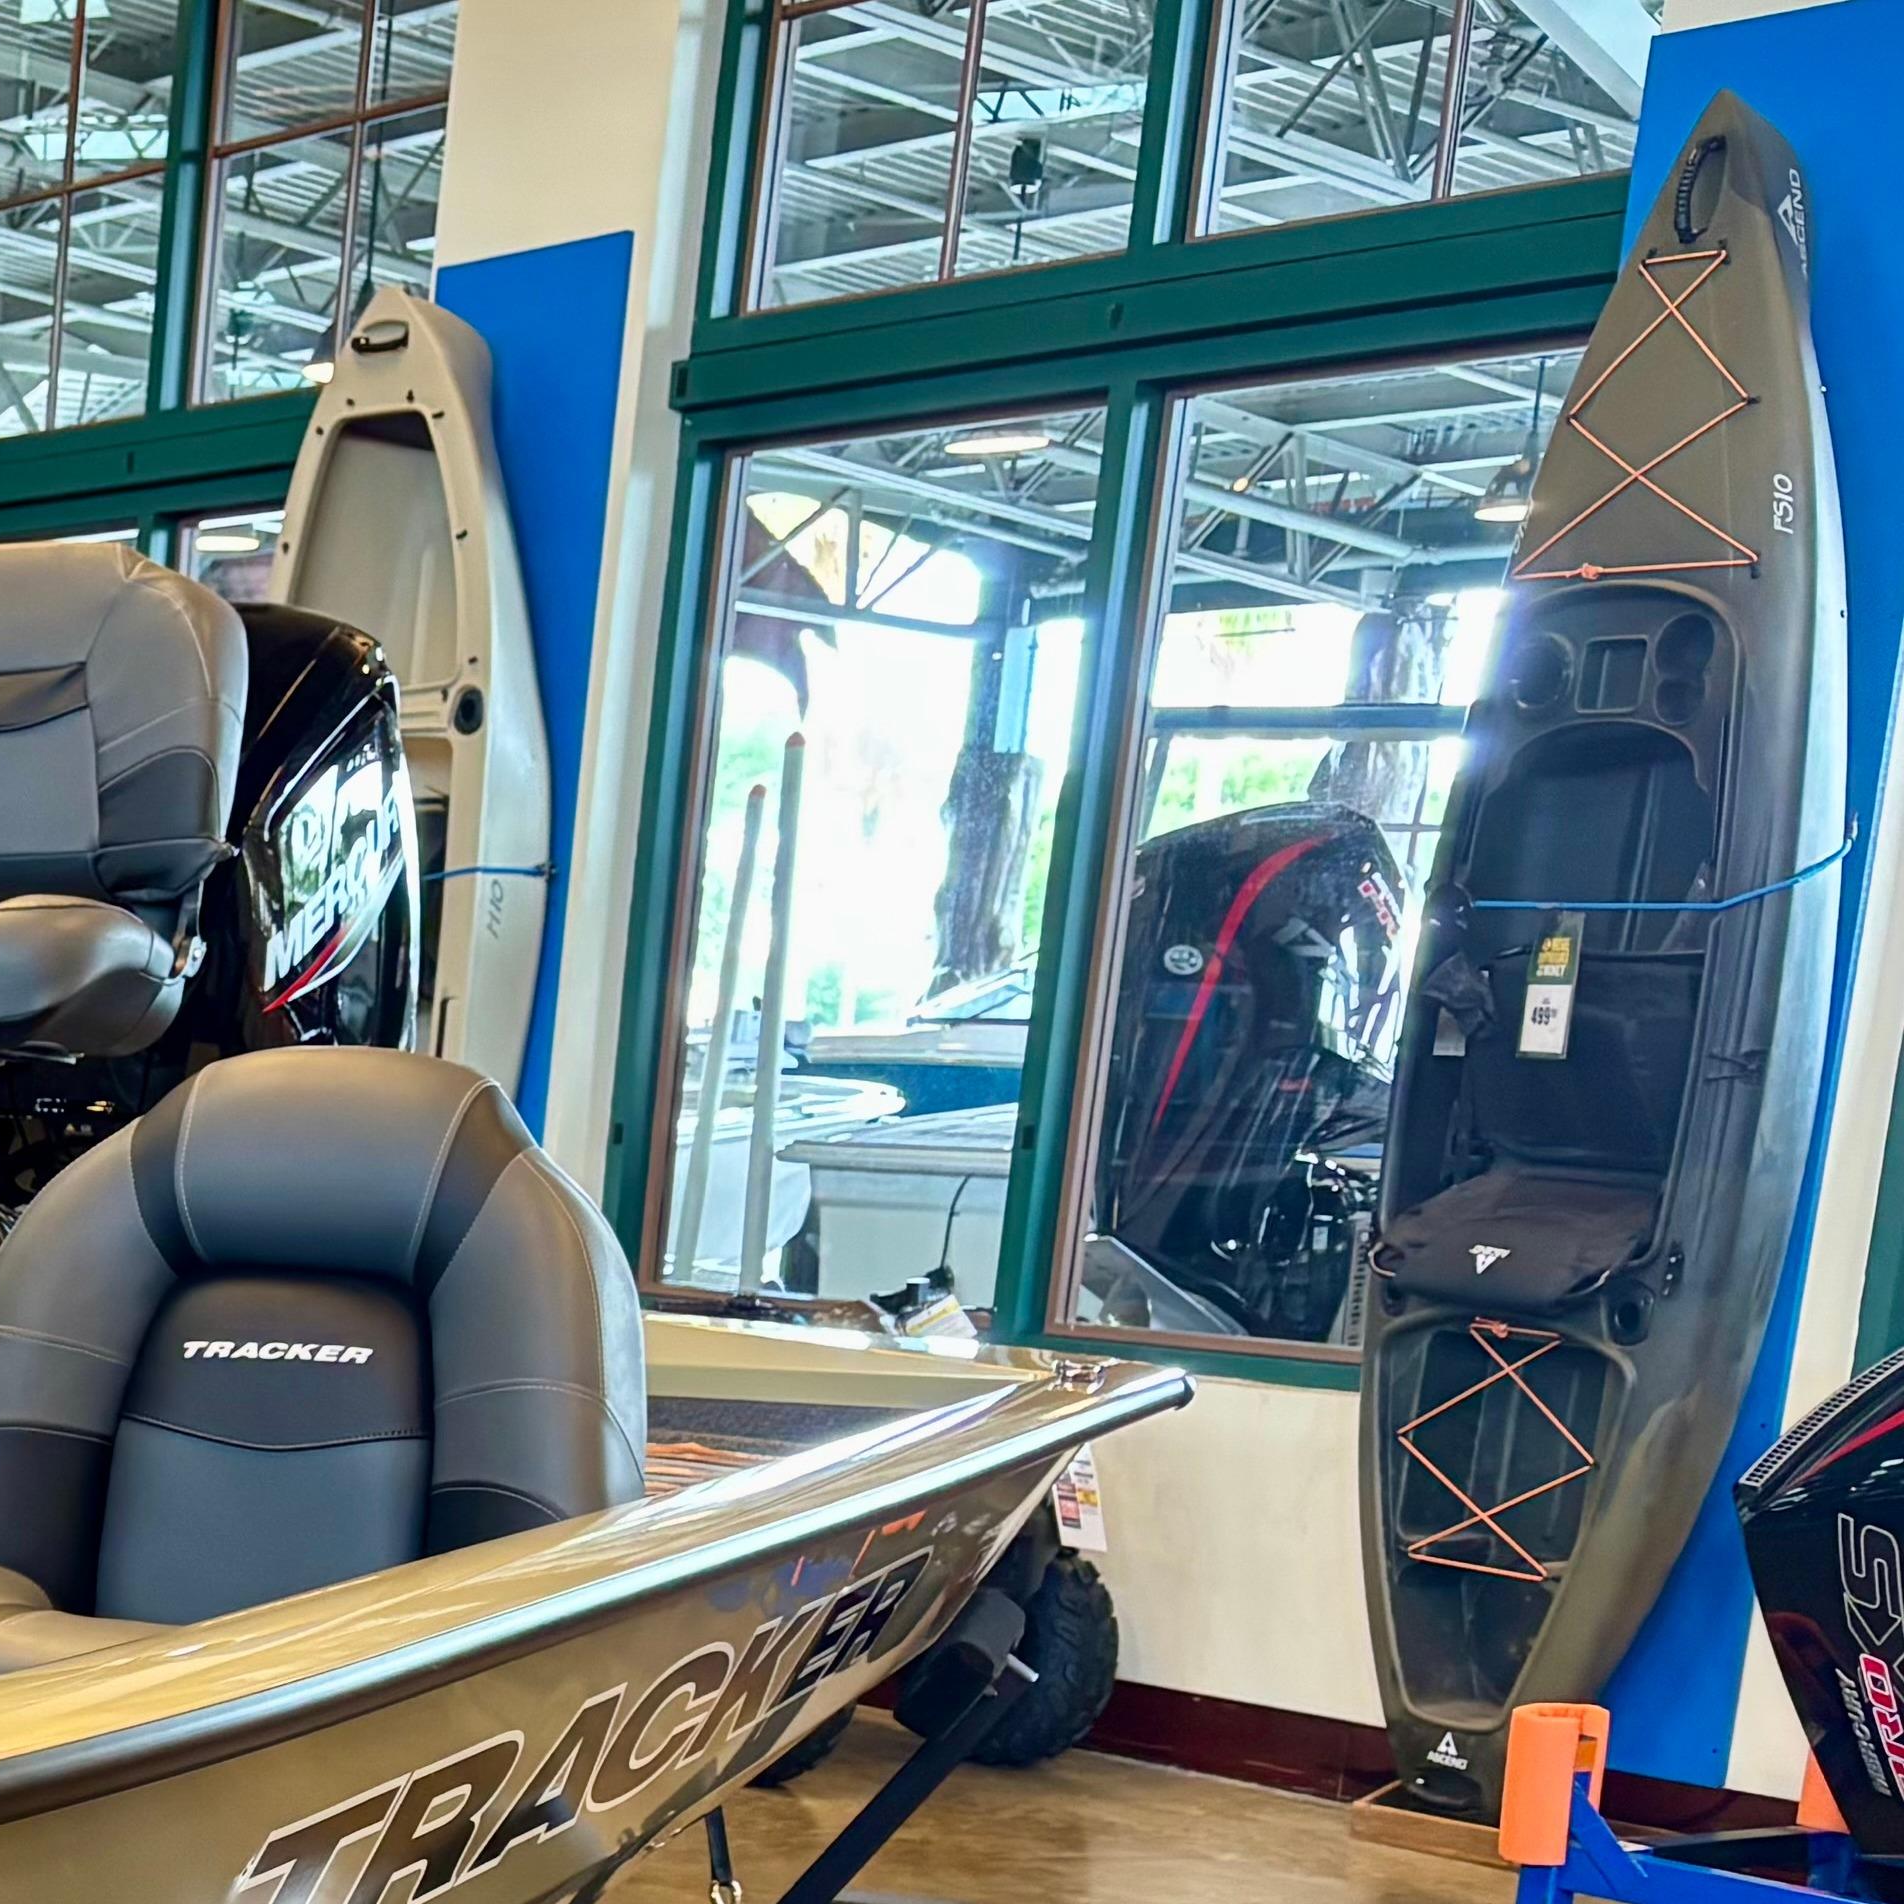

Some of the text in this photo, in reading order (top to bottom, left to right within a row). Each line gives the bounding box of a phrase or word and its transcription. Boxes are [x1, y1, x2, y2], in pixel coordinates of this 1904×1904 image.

[1772, 473, 1793, 535] FS10
[183, 1340, 374, 1364] TRACKER
[1834, 1667, 1893, 1797] MERCURY
